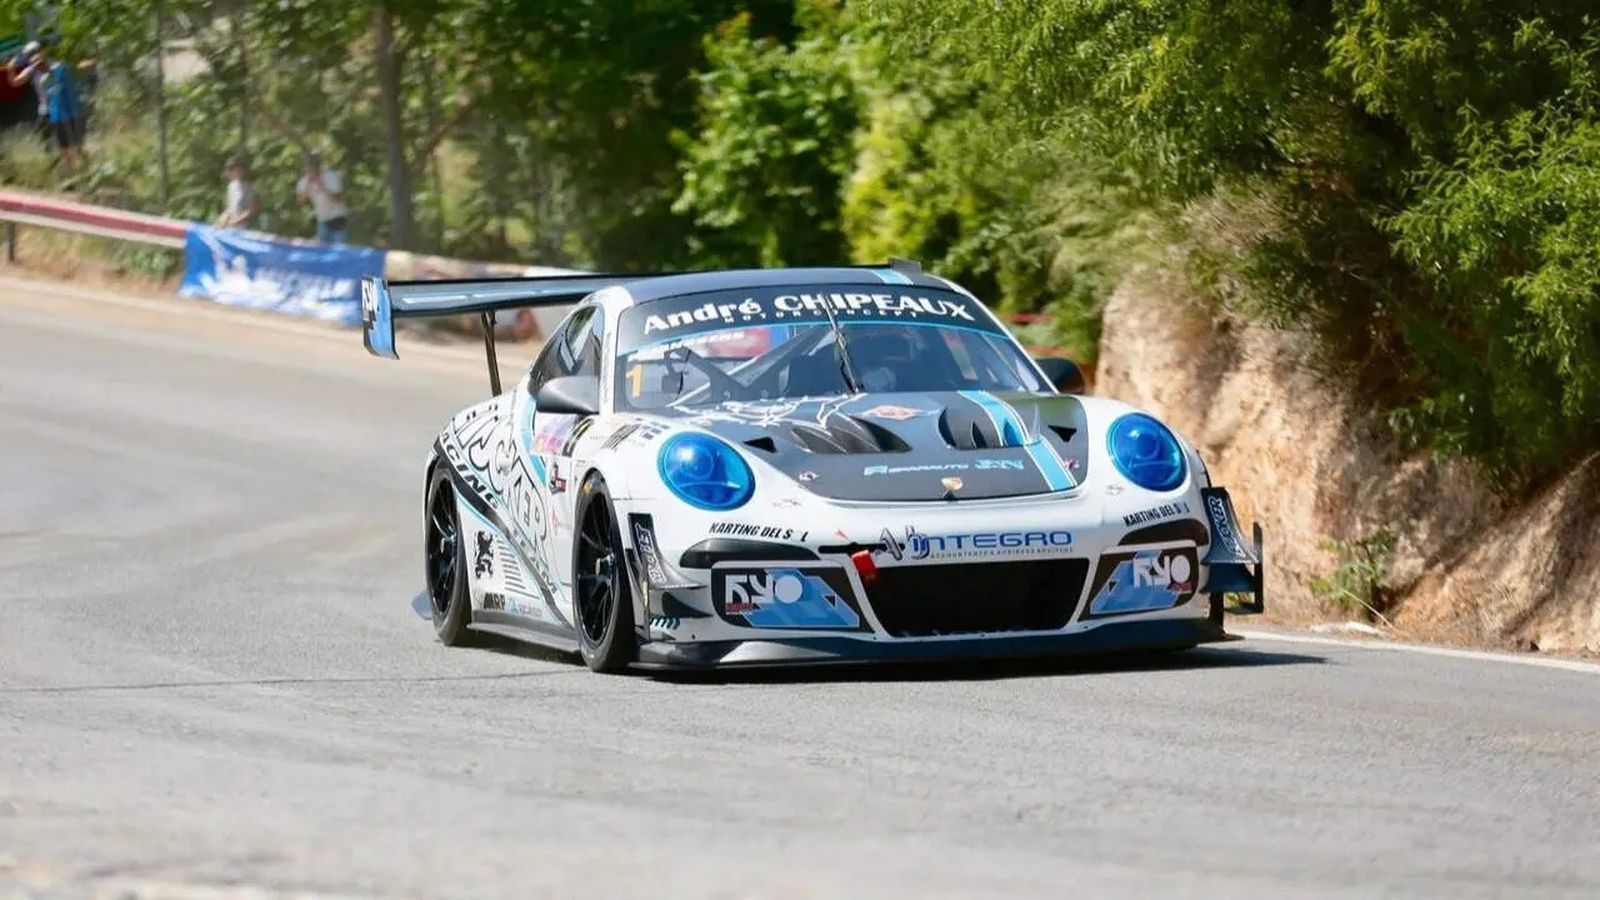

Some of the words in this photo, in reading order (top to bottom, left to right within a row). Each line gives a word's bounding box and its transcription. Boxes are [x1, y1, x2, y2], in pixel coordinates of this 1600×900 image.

[644, 298, 762, 334] André
[774, 293, 975, 321] CHIPEAUX
[626, 365, 642, 397] 1
[1123, 506, 1160, 527] KARTING
[1160, 503, 1174, 519] DEL
[709, 522, 760, 536] KARTING
[760, 526, 781, 539] DEL
[782, 529, 809, 542] SL
